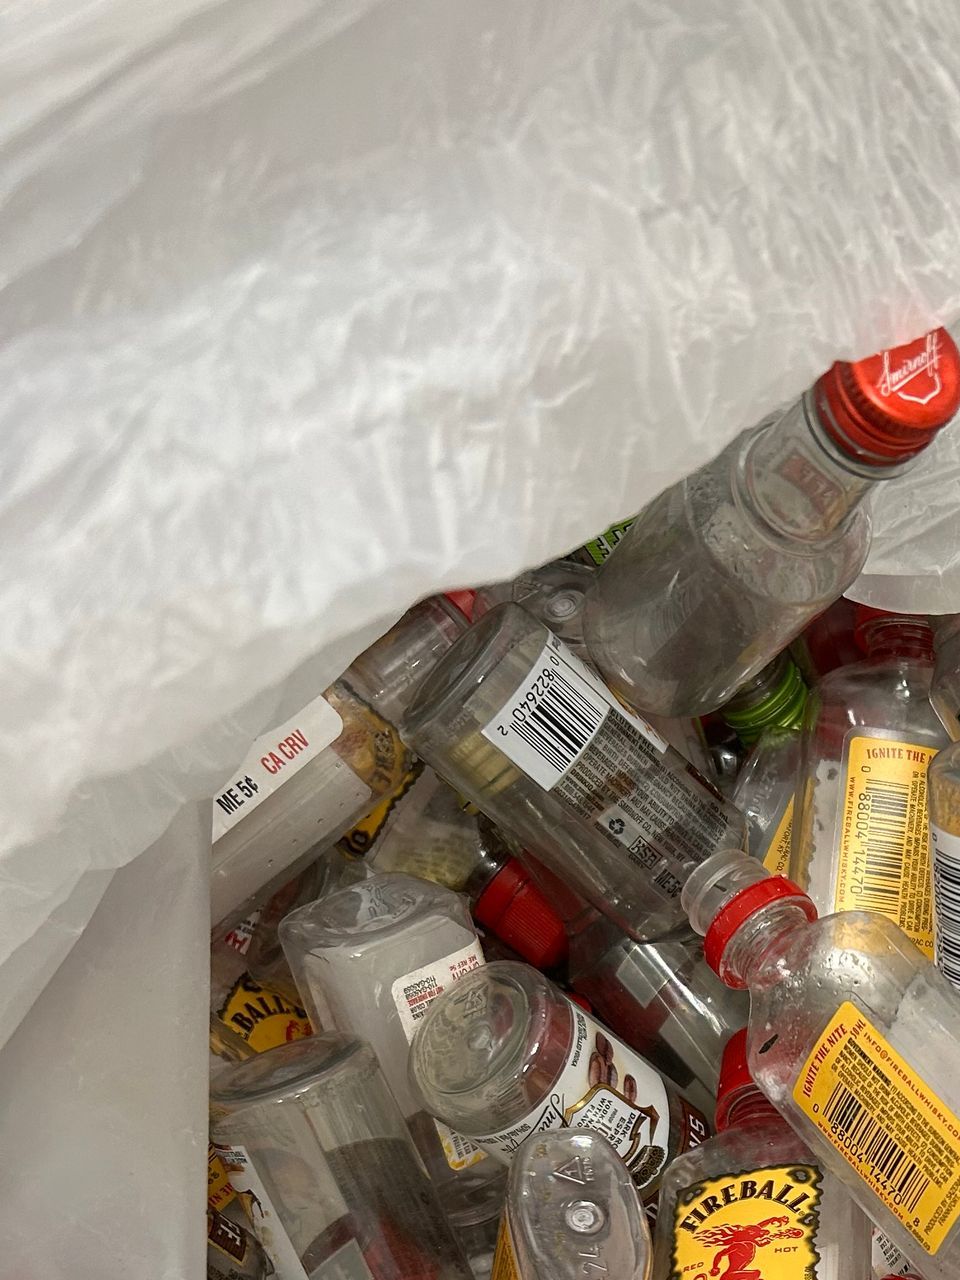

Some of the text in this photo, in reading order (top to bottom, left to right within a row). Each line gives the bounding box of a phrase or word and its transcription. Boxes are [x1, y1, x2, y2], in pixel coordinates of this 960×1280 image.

[496, 655, 560, 737] 0 822640 2
[259, 728, 311, 776] CA CRV
[863, 747, 927, 763] IGNITE THE
[214, 773, 261, 816] ME 5¢
[853, 792, 871, 839] 88004
[837, 776, 856, 902] WWW.FIREBALLWHISKY.COM
[653, 867, 677, 891] ME
[849, 849, 866, 894] 14470
[228, 992, 292, 1035] BALL
[799, 1023, 849, 1098] IGNITE THE NITE
[589, 1096, 611, 1118] WITH
[589, 1097, 618, 1126] VODKA
[612, 1110, 642, 1139] DARK
[810, 1102, 922, 1227] 0 88004 14470 8
[814, 1120, 905, 1220] WWW.FIREBALLWHISKY.COM
[680, 1173, 811, 1234] FIREBALL
[682, 1261, 705, 1272] RED
[773, 1242, 799, 1257] HOT
